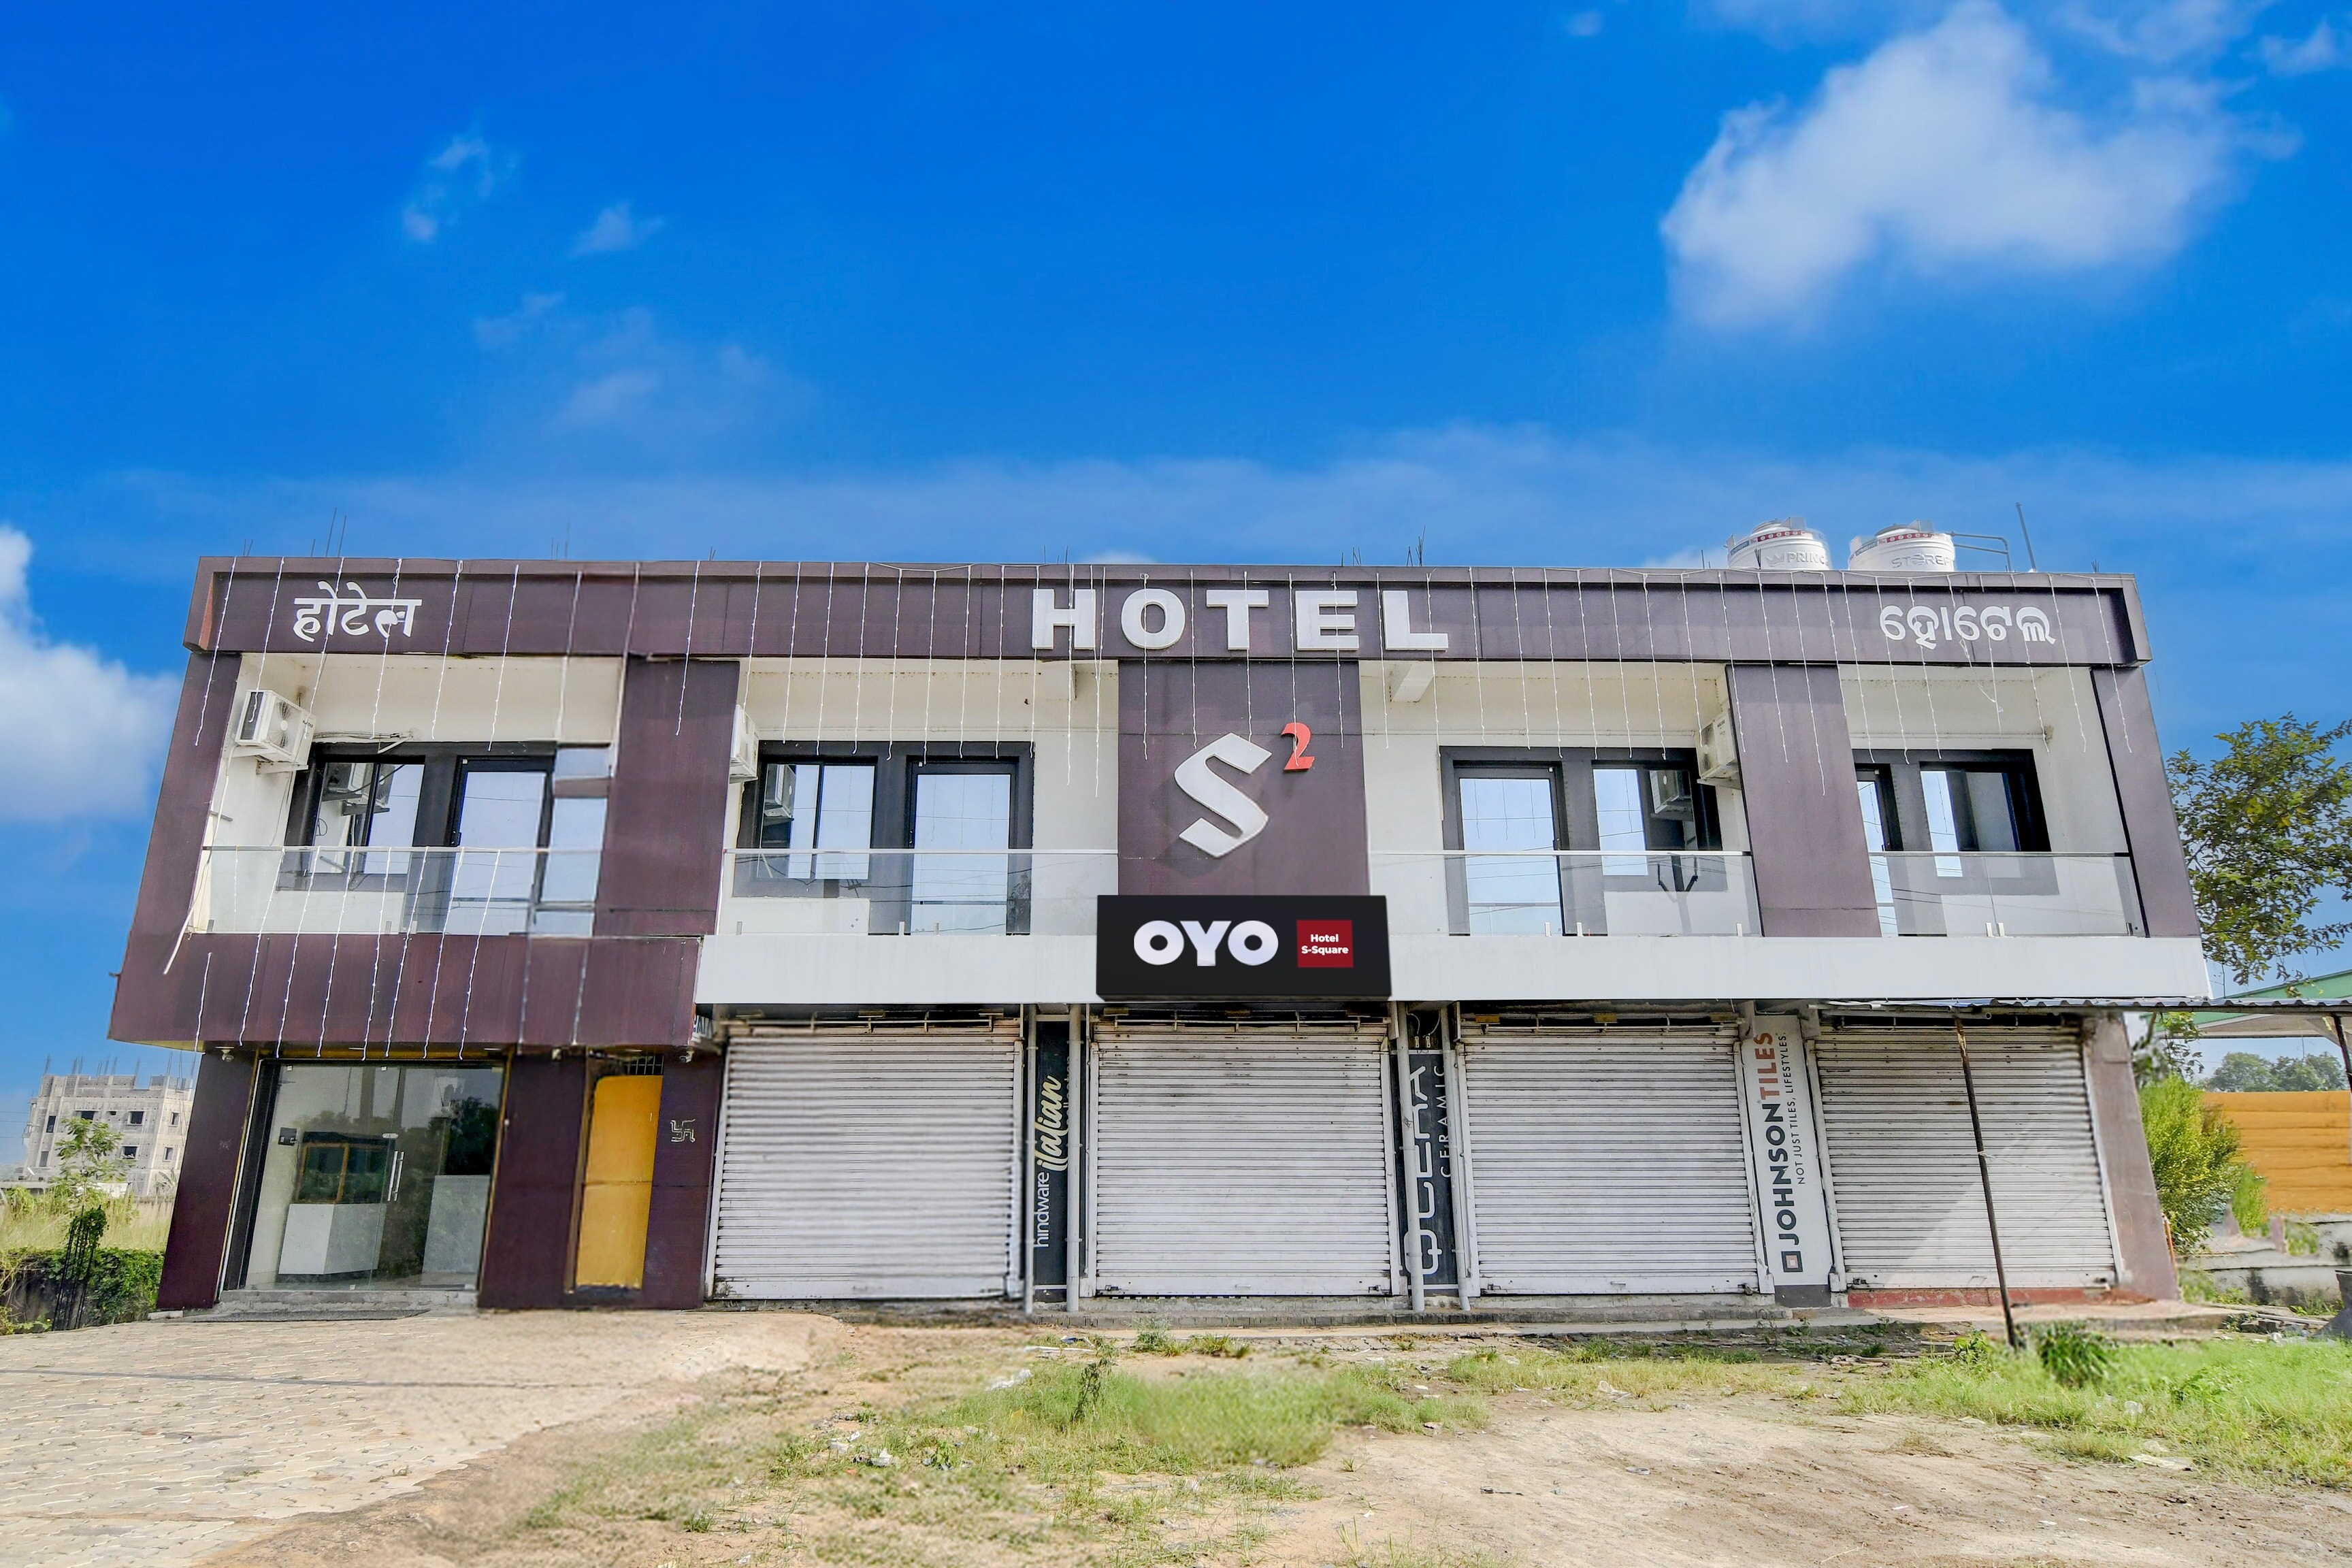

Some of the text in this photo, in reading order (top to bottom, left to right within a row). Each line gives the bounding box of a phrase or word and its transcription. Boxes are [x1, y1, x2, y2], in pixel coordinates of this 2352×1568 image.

[1786, 551, 1829, 566] PRINC
[293, 581, 423, 642] होटेल
[1032, 588, 1449, 651] HOTEL
[1880, 605, 2056, 650] ହୋଟେଲ
[1133, 919, 1279, 966] OYO
[1301, 945, 1349, 956] S-Square
[1310, 934, 1339, 943] Hotel
[1433, 1064, 1451, 1178] CERAMIC
[1791, 1132, 1803, 1158] JUST
[1795, 1161, 1806, 1185] NOT
[1033, 1171, 1049, 1247] hindware
